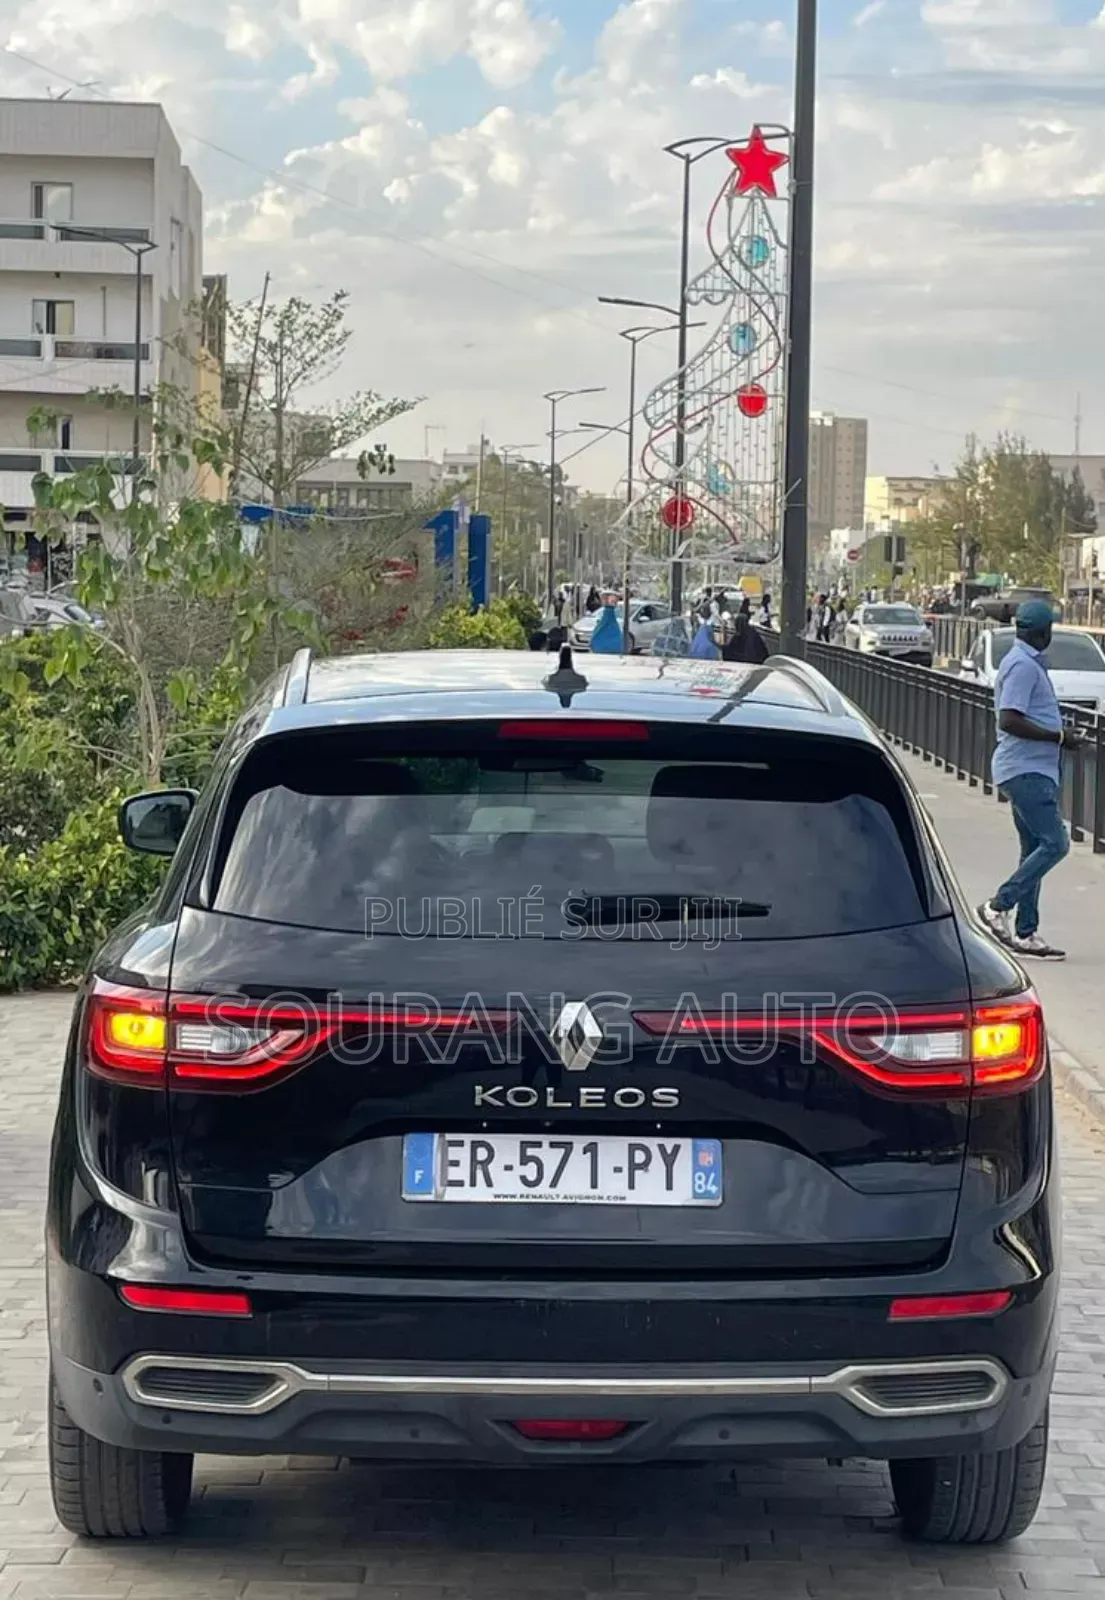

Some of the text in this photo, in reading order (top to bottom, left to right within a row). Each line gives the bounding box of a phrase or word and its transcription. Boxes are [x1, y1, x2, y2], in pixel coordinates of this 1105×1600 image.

[474, 1085, 680, 1108] KOLEOS
[442, 1139, 682, 1191] ER-571-PY
[414, 1169, 424, 1185] F
[694, 1171, 719, 1194] 84
